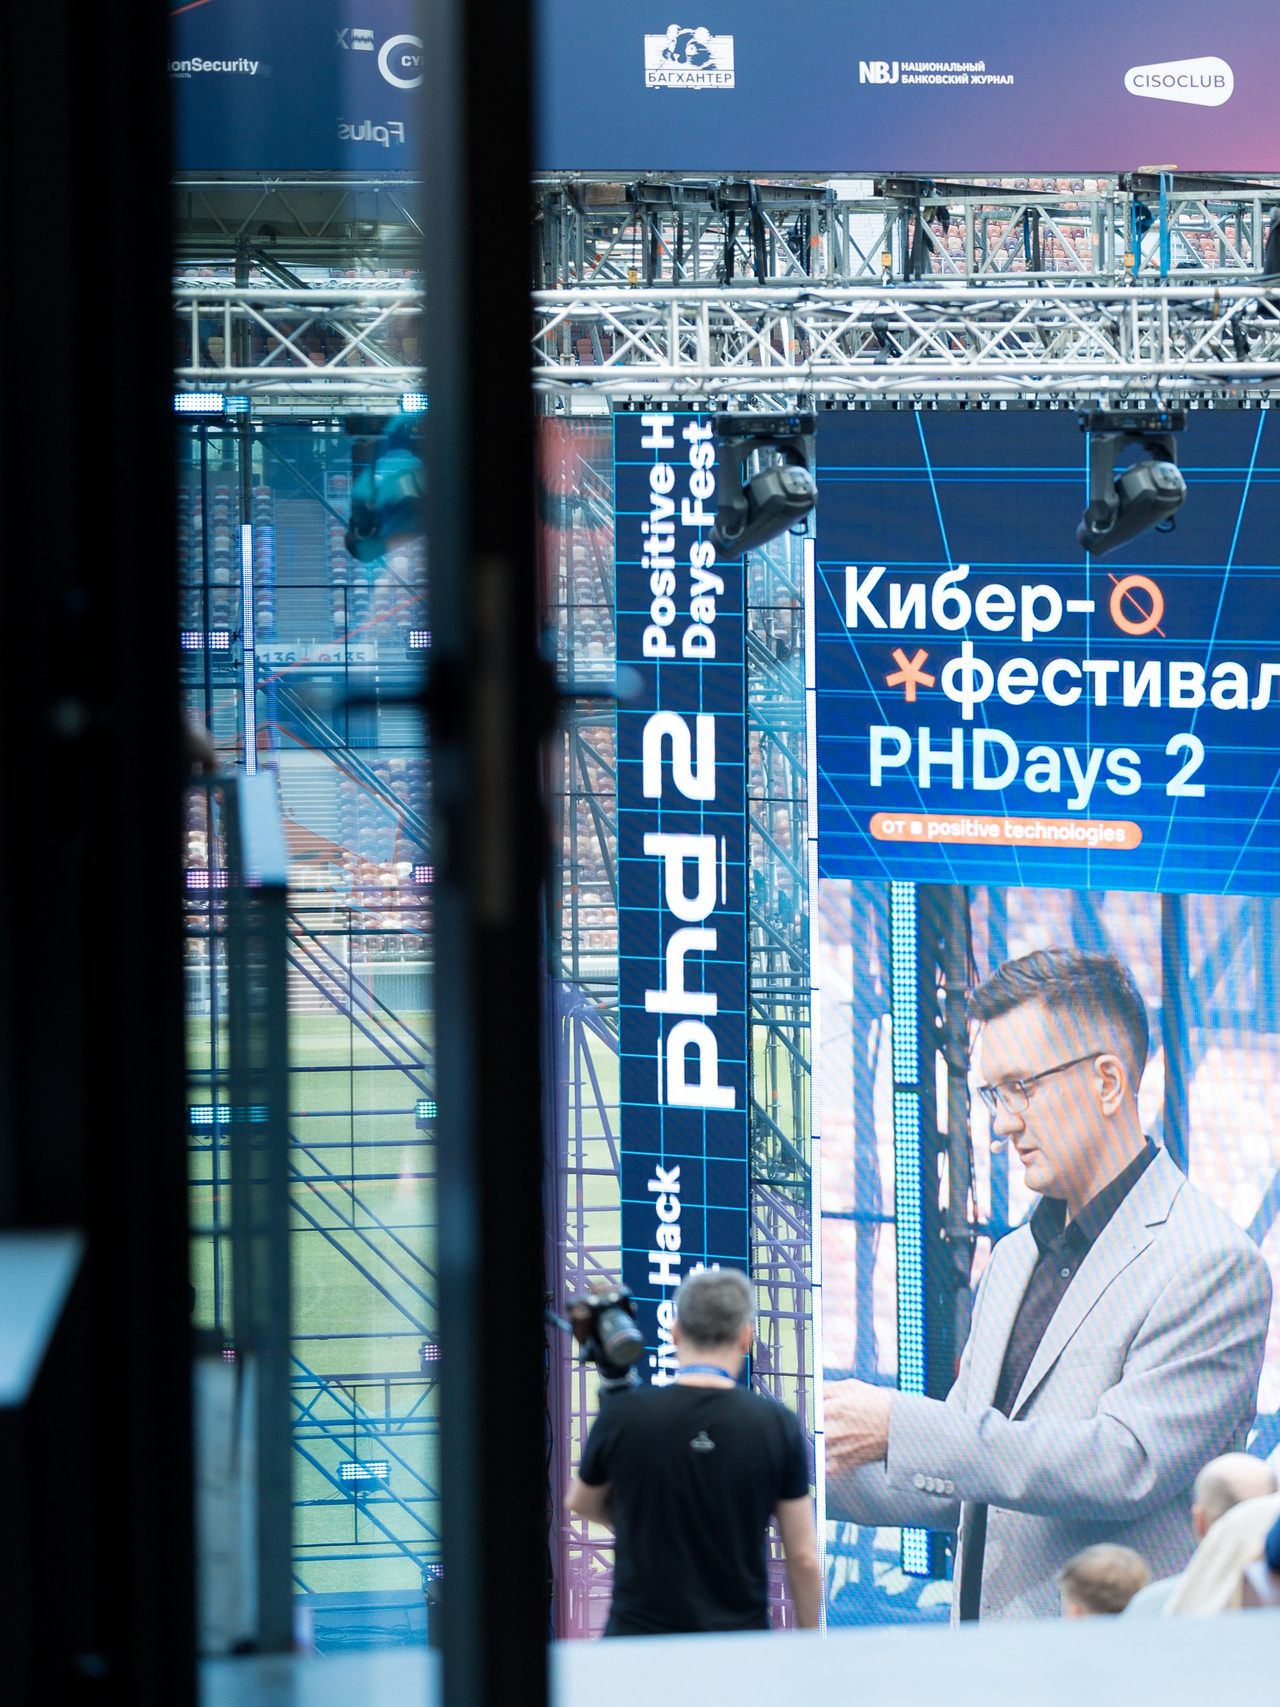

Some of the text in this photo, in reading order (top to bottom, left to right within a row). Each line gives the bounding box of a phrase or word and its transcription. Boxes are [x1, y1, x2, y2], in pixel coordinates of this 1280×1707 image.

[167, 57, 259, 75] ionSecurity
[648, 72, 733, 83] БАГХАНТЕР
[858, 61, 899, 84] NBJ
[901, 61, 986, 72] НАЦИОНАЛЬНЫЙ
[901, 73, 1014, 84] БАНКОВСКИЙ ЖУРНАЛ
[1133, 74, 1226, 88] CISOCLUB
[681, 420, 724, 659] Days Fest
[641, 462, 677, 658] Positive
[844, 564, 1096, 642] Кибер-
[642, 710, 716, 801] 2
[869, 725, 1205, 811] PHDays 2
[927, 819, 1001, 840] positive
[1003, 821, 1126, 846] technologies
[647, 1163, 682, 1388] tive Hack
